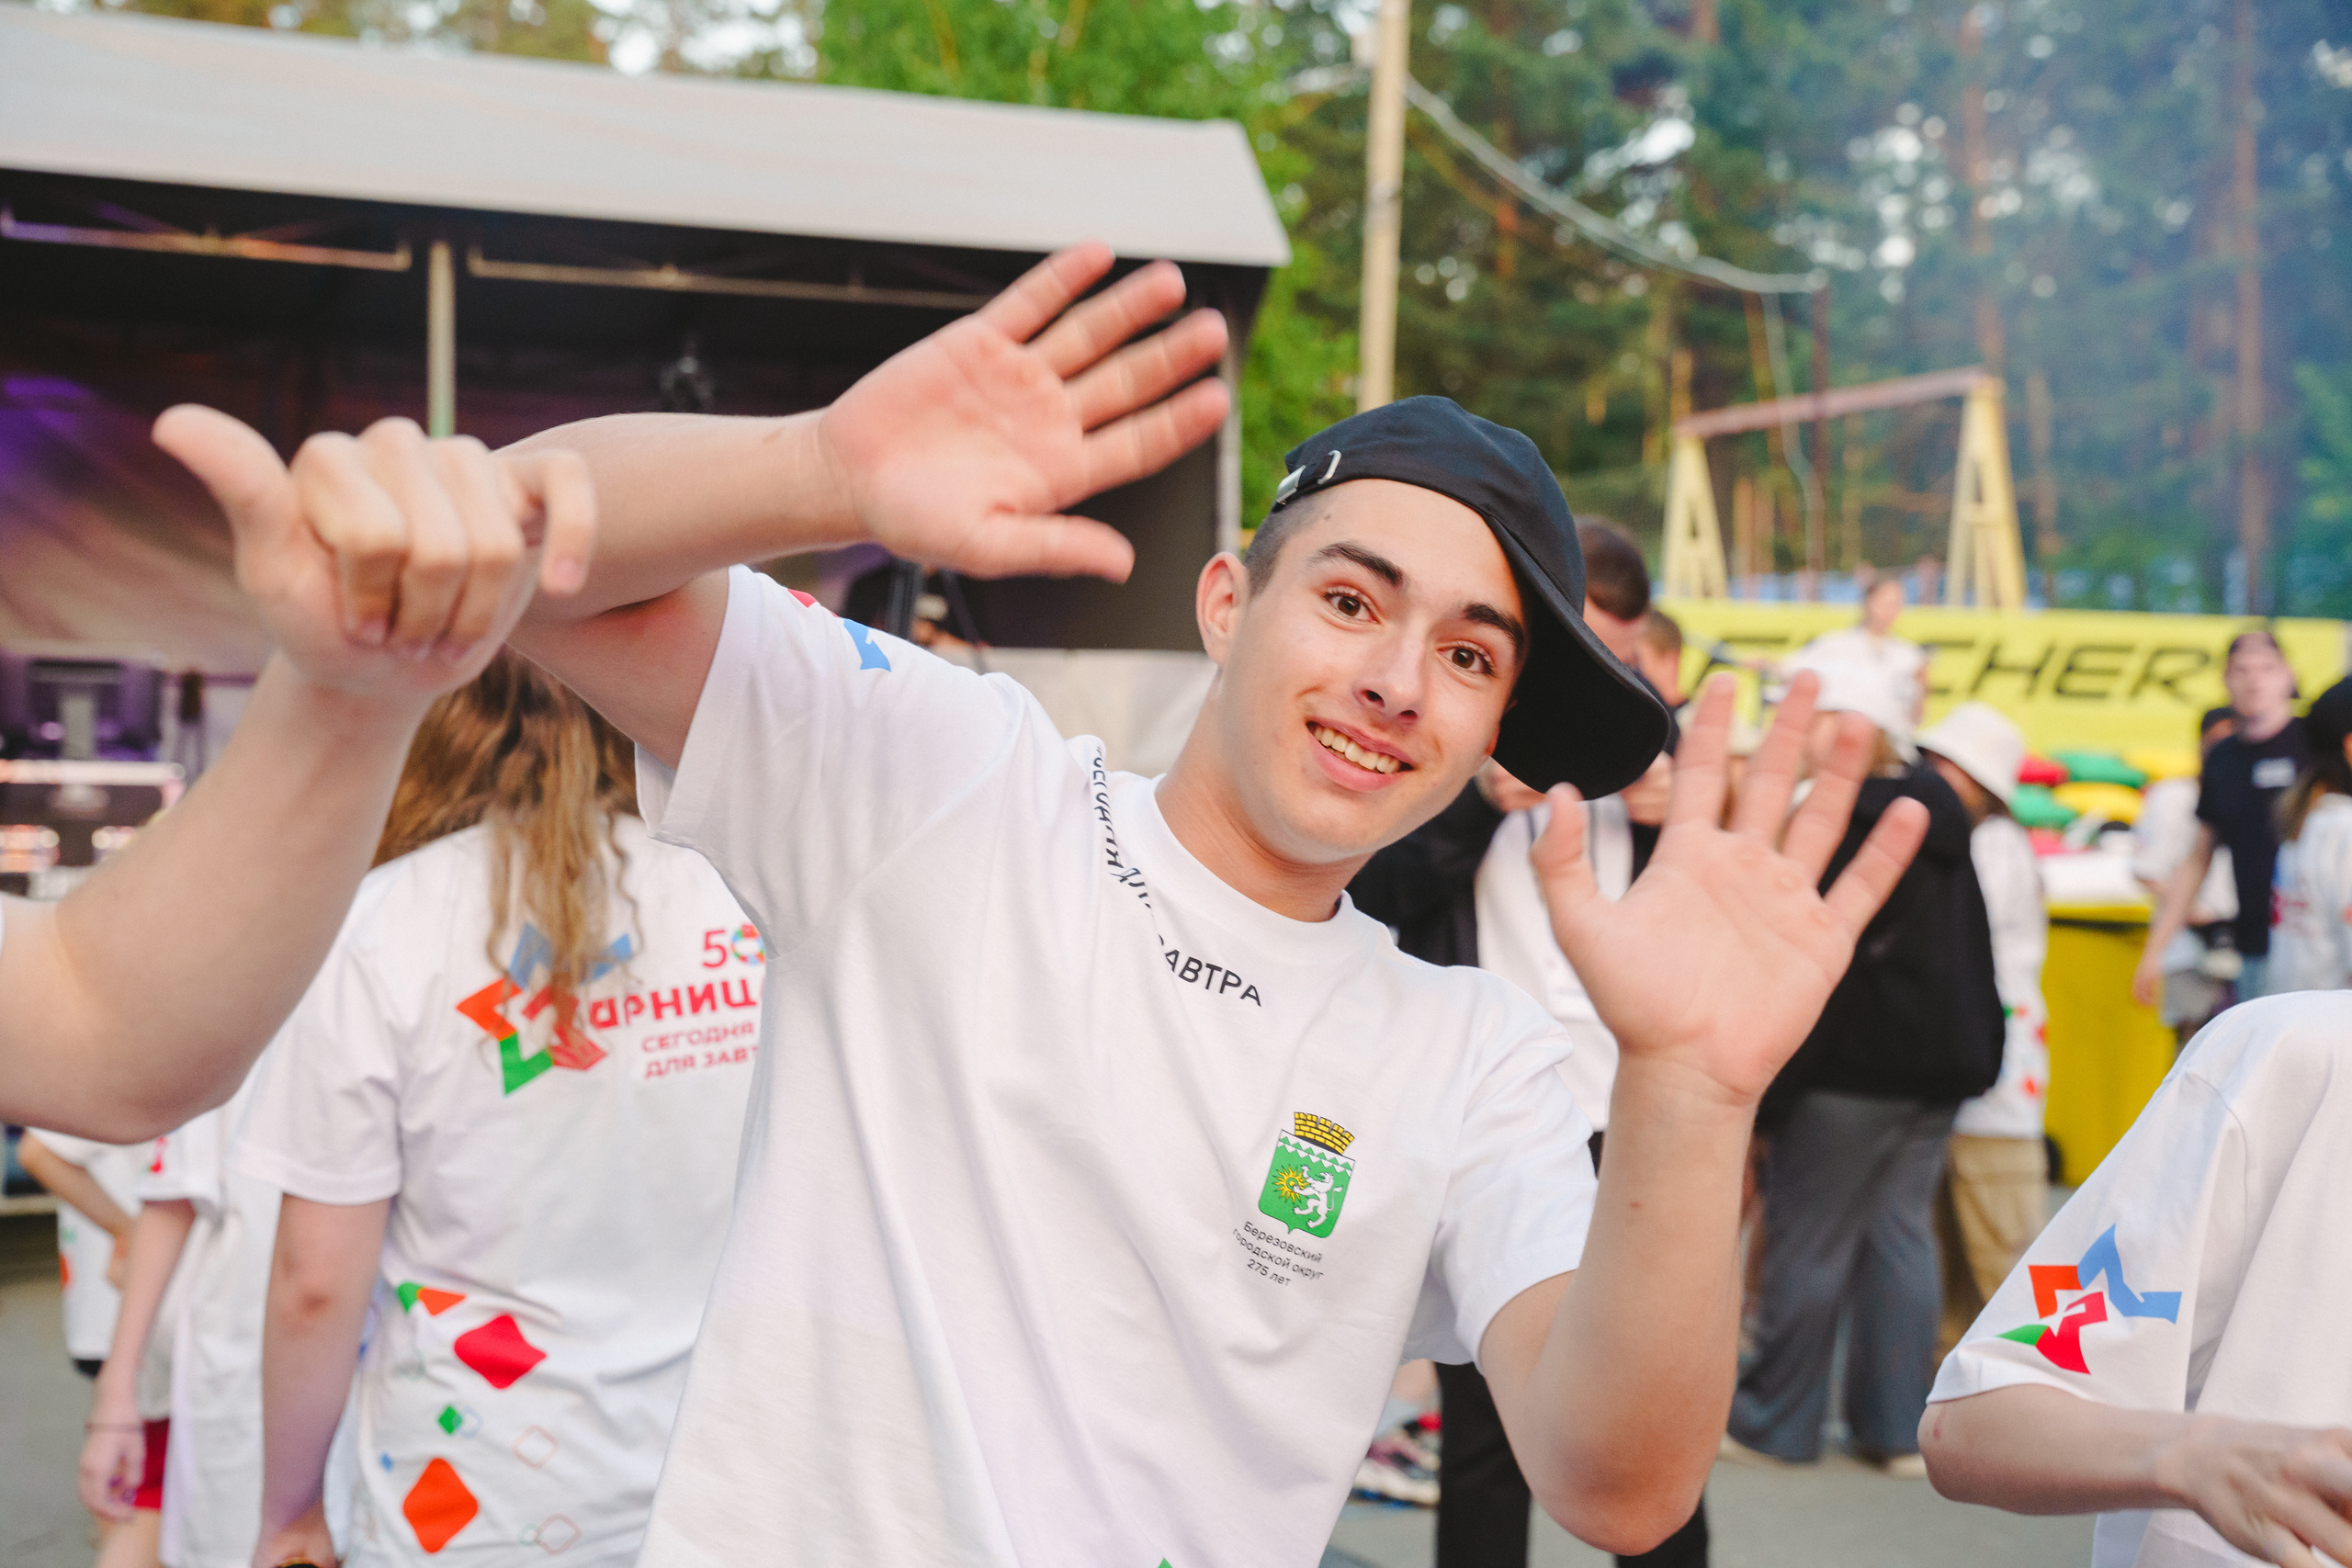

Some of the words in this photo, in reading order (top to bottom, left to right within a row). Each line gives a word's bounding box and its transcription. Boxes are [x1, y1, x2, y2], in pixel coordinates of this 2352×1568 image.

[644, 1055, 695, 1079] ДЛЯ
[1232, 1227, 1292, 1269] городской
[1243, 1220, 1323, 1263] Березовский
[1246, 1258, 1270, 1277] 275
[1268, 1272, 1292, 1287] лет
